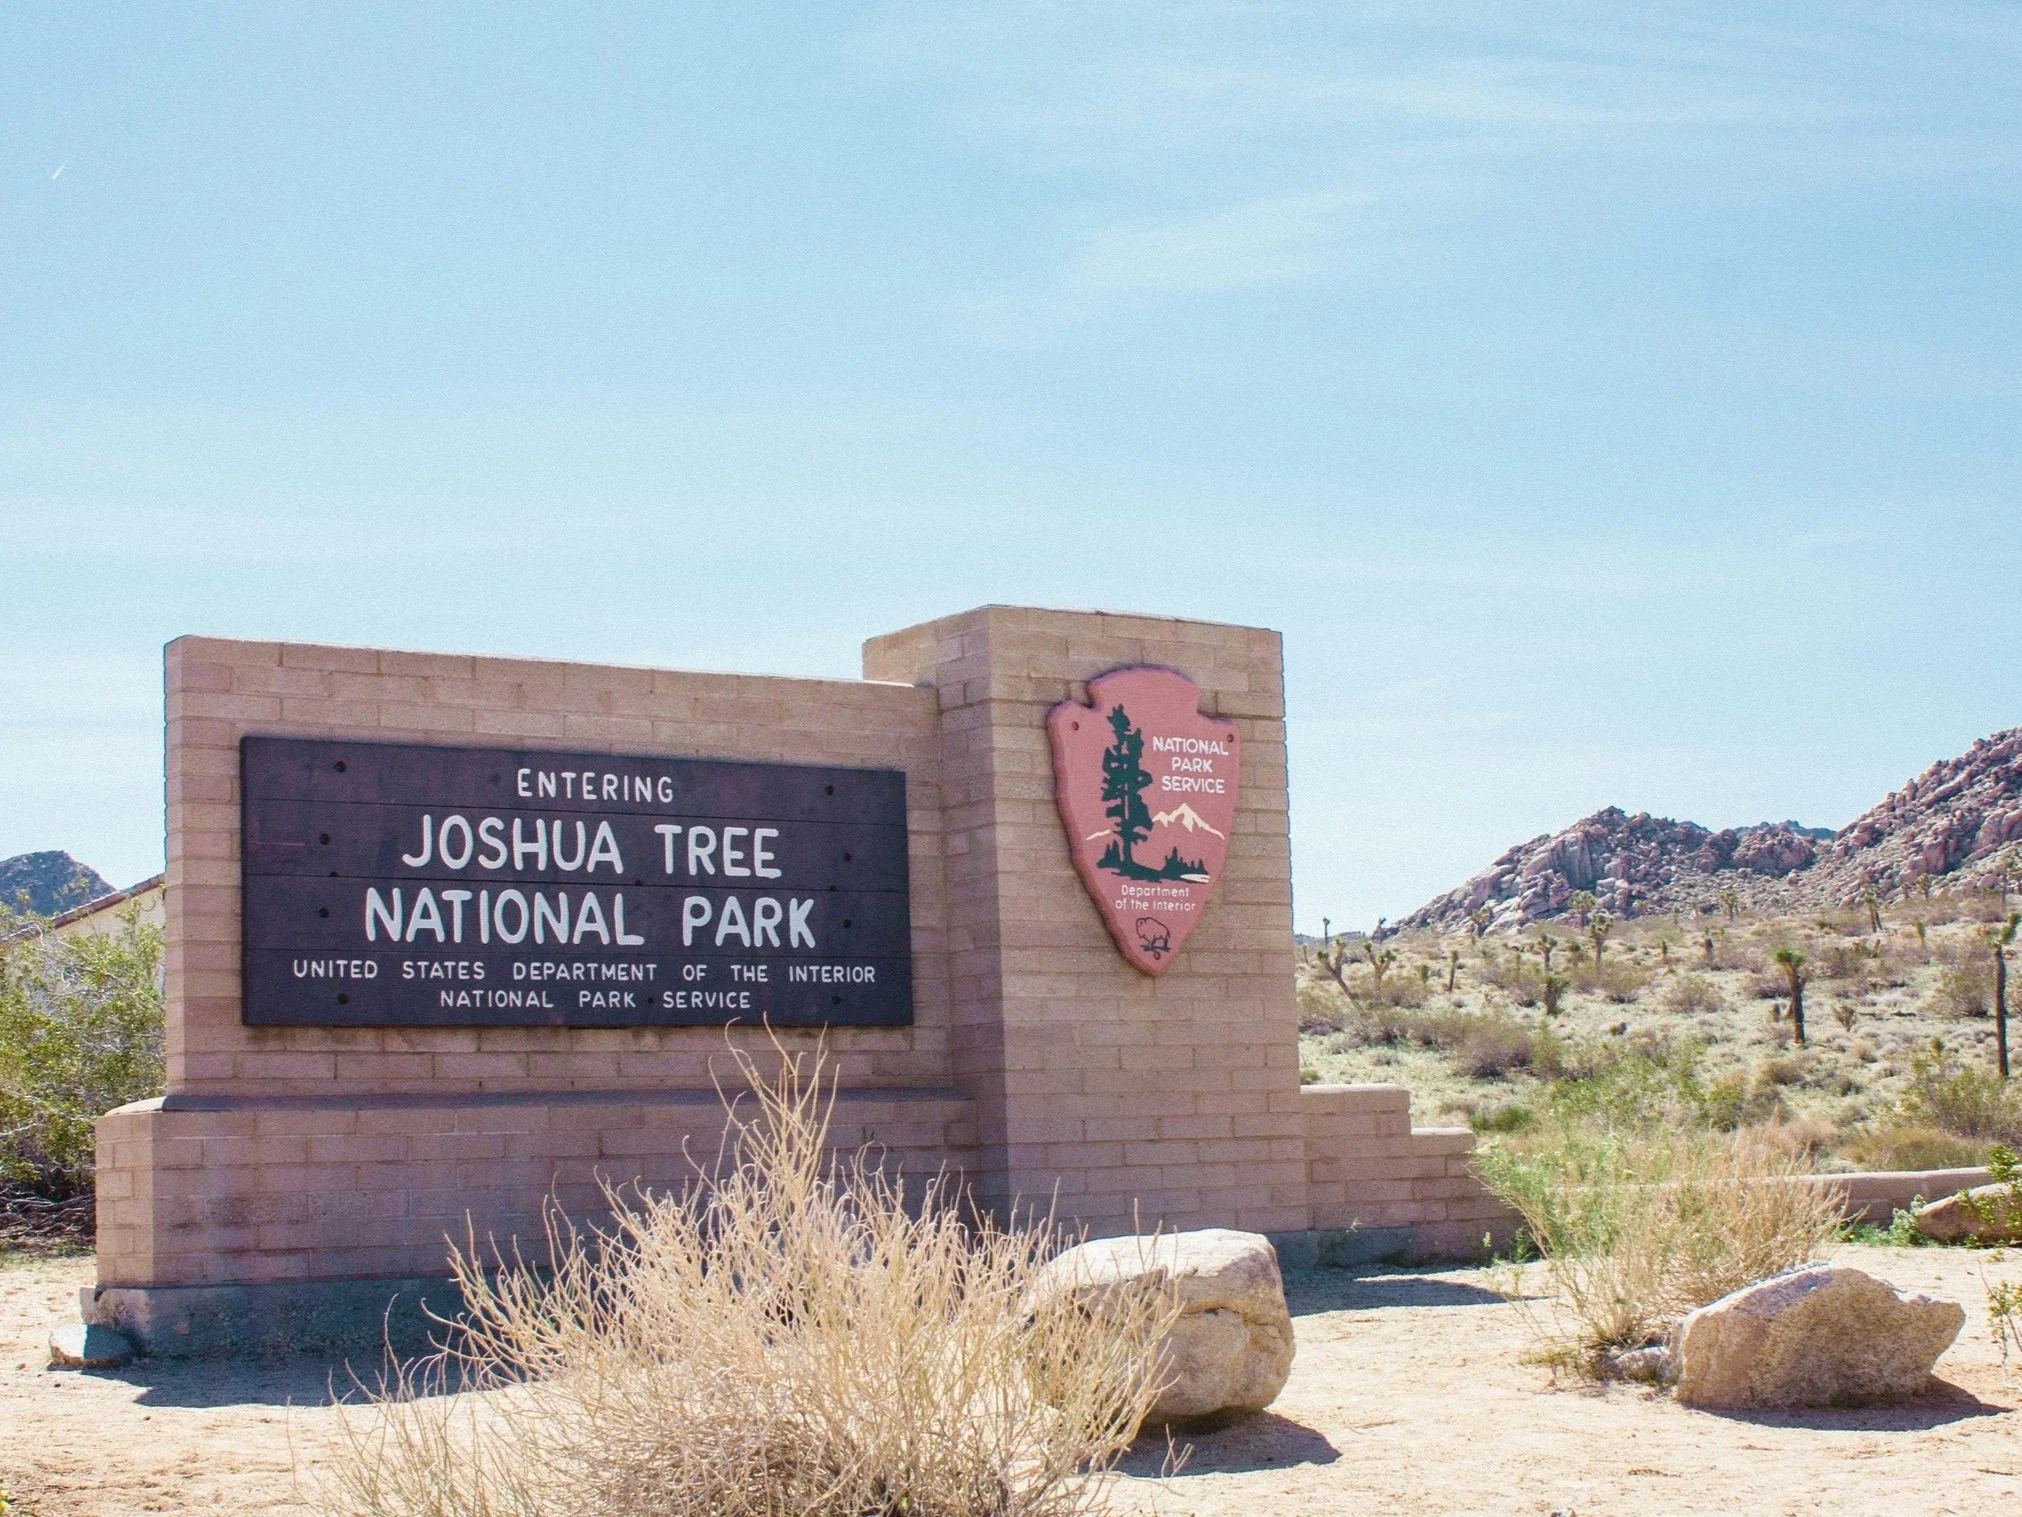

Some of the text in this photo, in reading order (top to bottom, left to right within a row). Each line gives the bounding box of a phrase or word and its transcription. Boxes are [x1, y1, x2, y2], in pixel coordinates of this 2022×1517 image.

[1152, 735, 1230, 756] NATIONAL
[1171, 756, 1214, 774] PARK
[517, 767, 674, 804] ENTERING
[1161, 775, 1226, 794] SERVICE
[401, 814, 782, 879] JOSHUA TREE
[1121, 884, 1190, 898] Department
[1114, 897, 1127, 911] of
[1130, 898, 1150, 911] the
[365, 886, 816, 949] NATIONAL PARK
[293, 959, 875, 983] UNITED STATES DEPARTMENT OF THE INTERIOR
[440, 989, 751, 1009] NATIONAL PARK SERVICE
